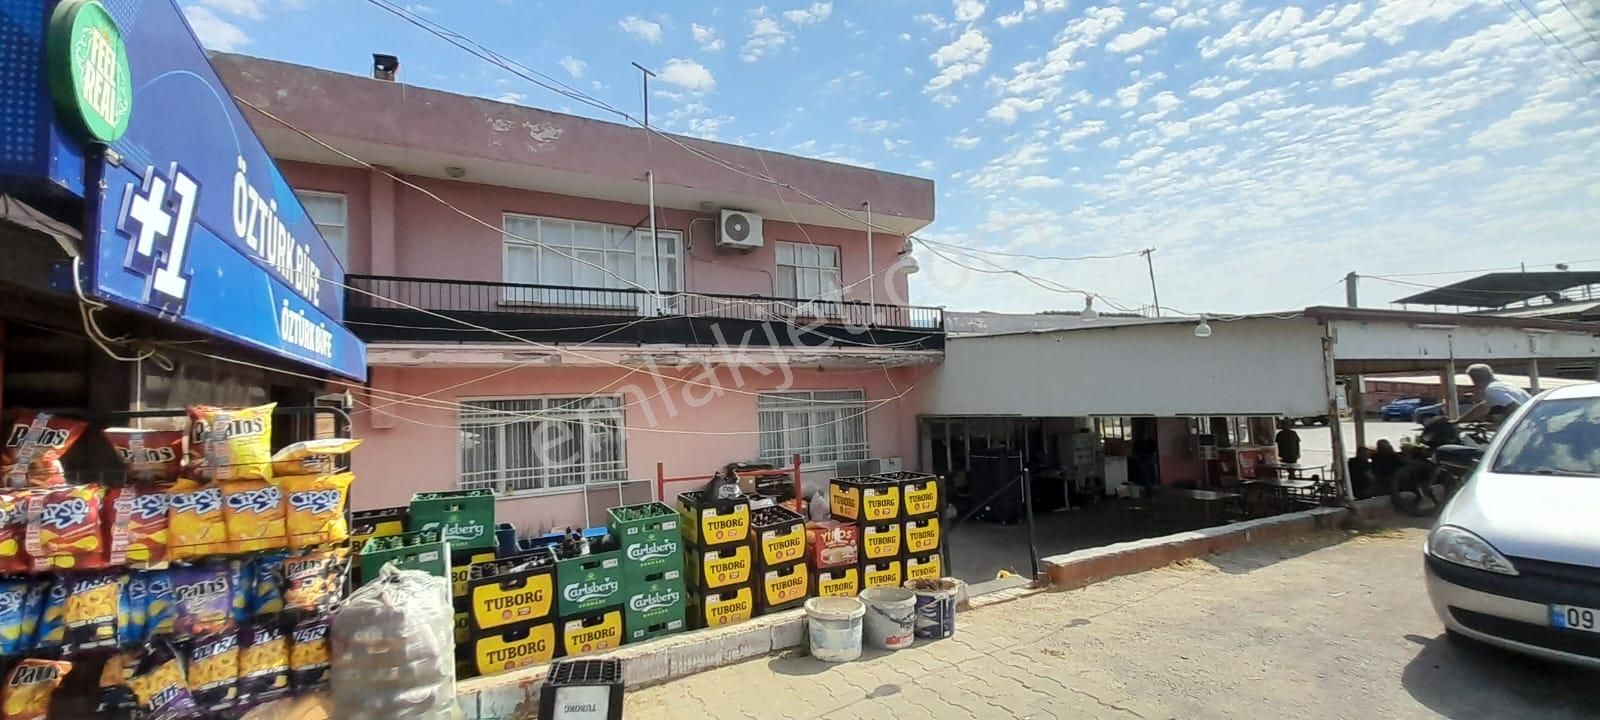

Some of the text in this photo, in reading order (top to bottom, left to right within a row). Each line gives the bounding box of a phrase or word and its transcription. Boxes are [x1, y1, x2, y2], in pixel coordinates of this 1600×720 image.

[91, 27, 116, 88] FEEL
[83, 58, 116, 128] REAL
[232, 155, 320, 307] ÖZTÜRK BÜFE
[281, 298, 333, 358] ÖZTÜRK BÜFE
[868, 499, 895, 509] TUBORG
[909, 493, 934, 504] TUBORG
[708, 518, 744, 531] TUBORG
[767, 536, 800, 551] TUBORG
[869, 535, 896, 546] TUBORG
[910, 530, 935, 541] TUBORG
[627, 538, 677, 561] Carlsberg
[710, 560, 745, 574] TUBORG
[911, 566, 937, 577] TUBORG
[770, 577, 803, 593] TUBORG
[824, 581, 853, 594] TUBORG
[869, 574, 896, 585] TUBORG
[564, 577, 618, 602] Carlsberg
[484, 590, 543, 612] TUBORG
[630, 588, 679, 612] Carlsberg
[711, 601, 747, 616] TUBORG
[1567, 607, 1595, 629] 09
[571, 627, 615, 645] TUBORG
[486, 640, 546, 664] TUBORG
